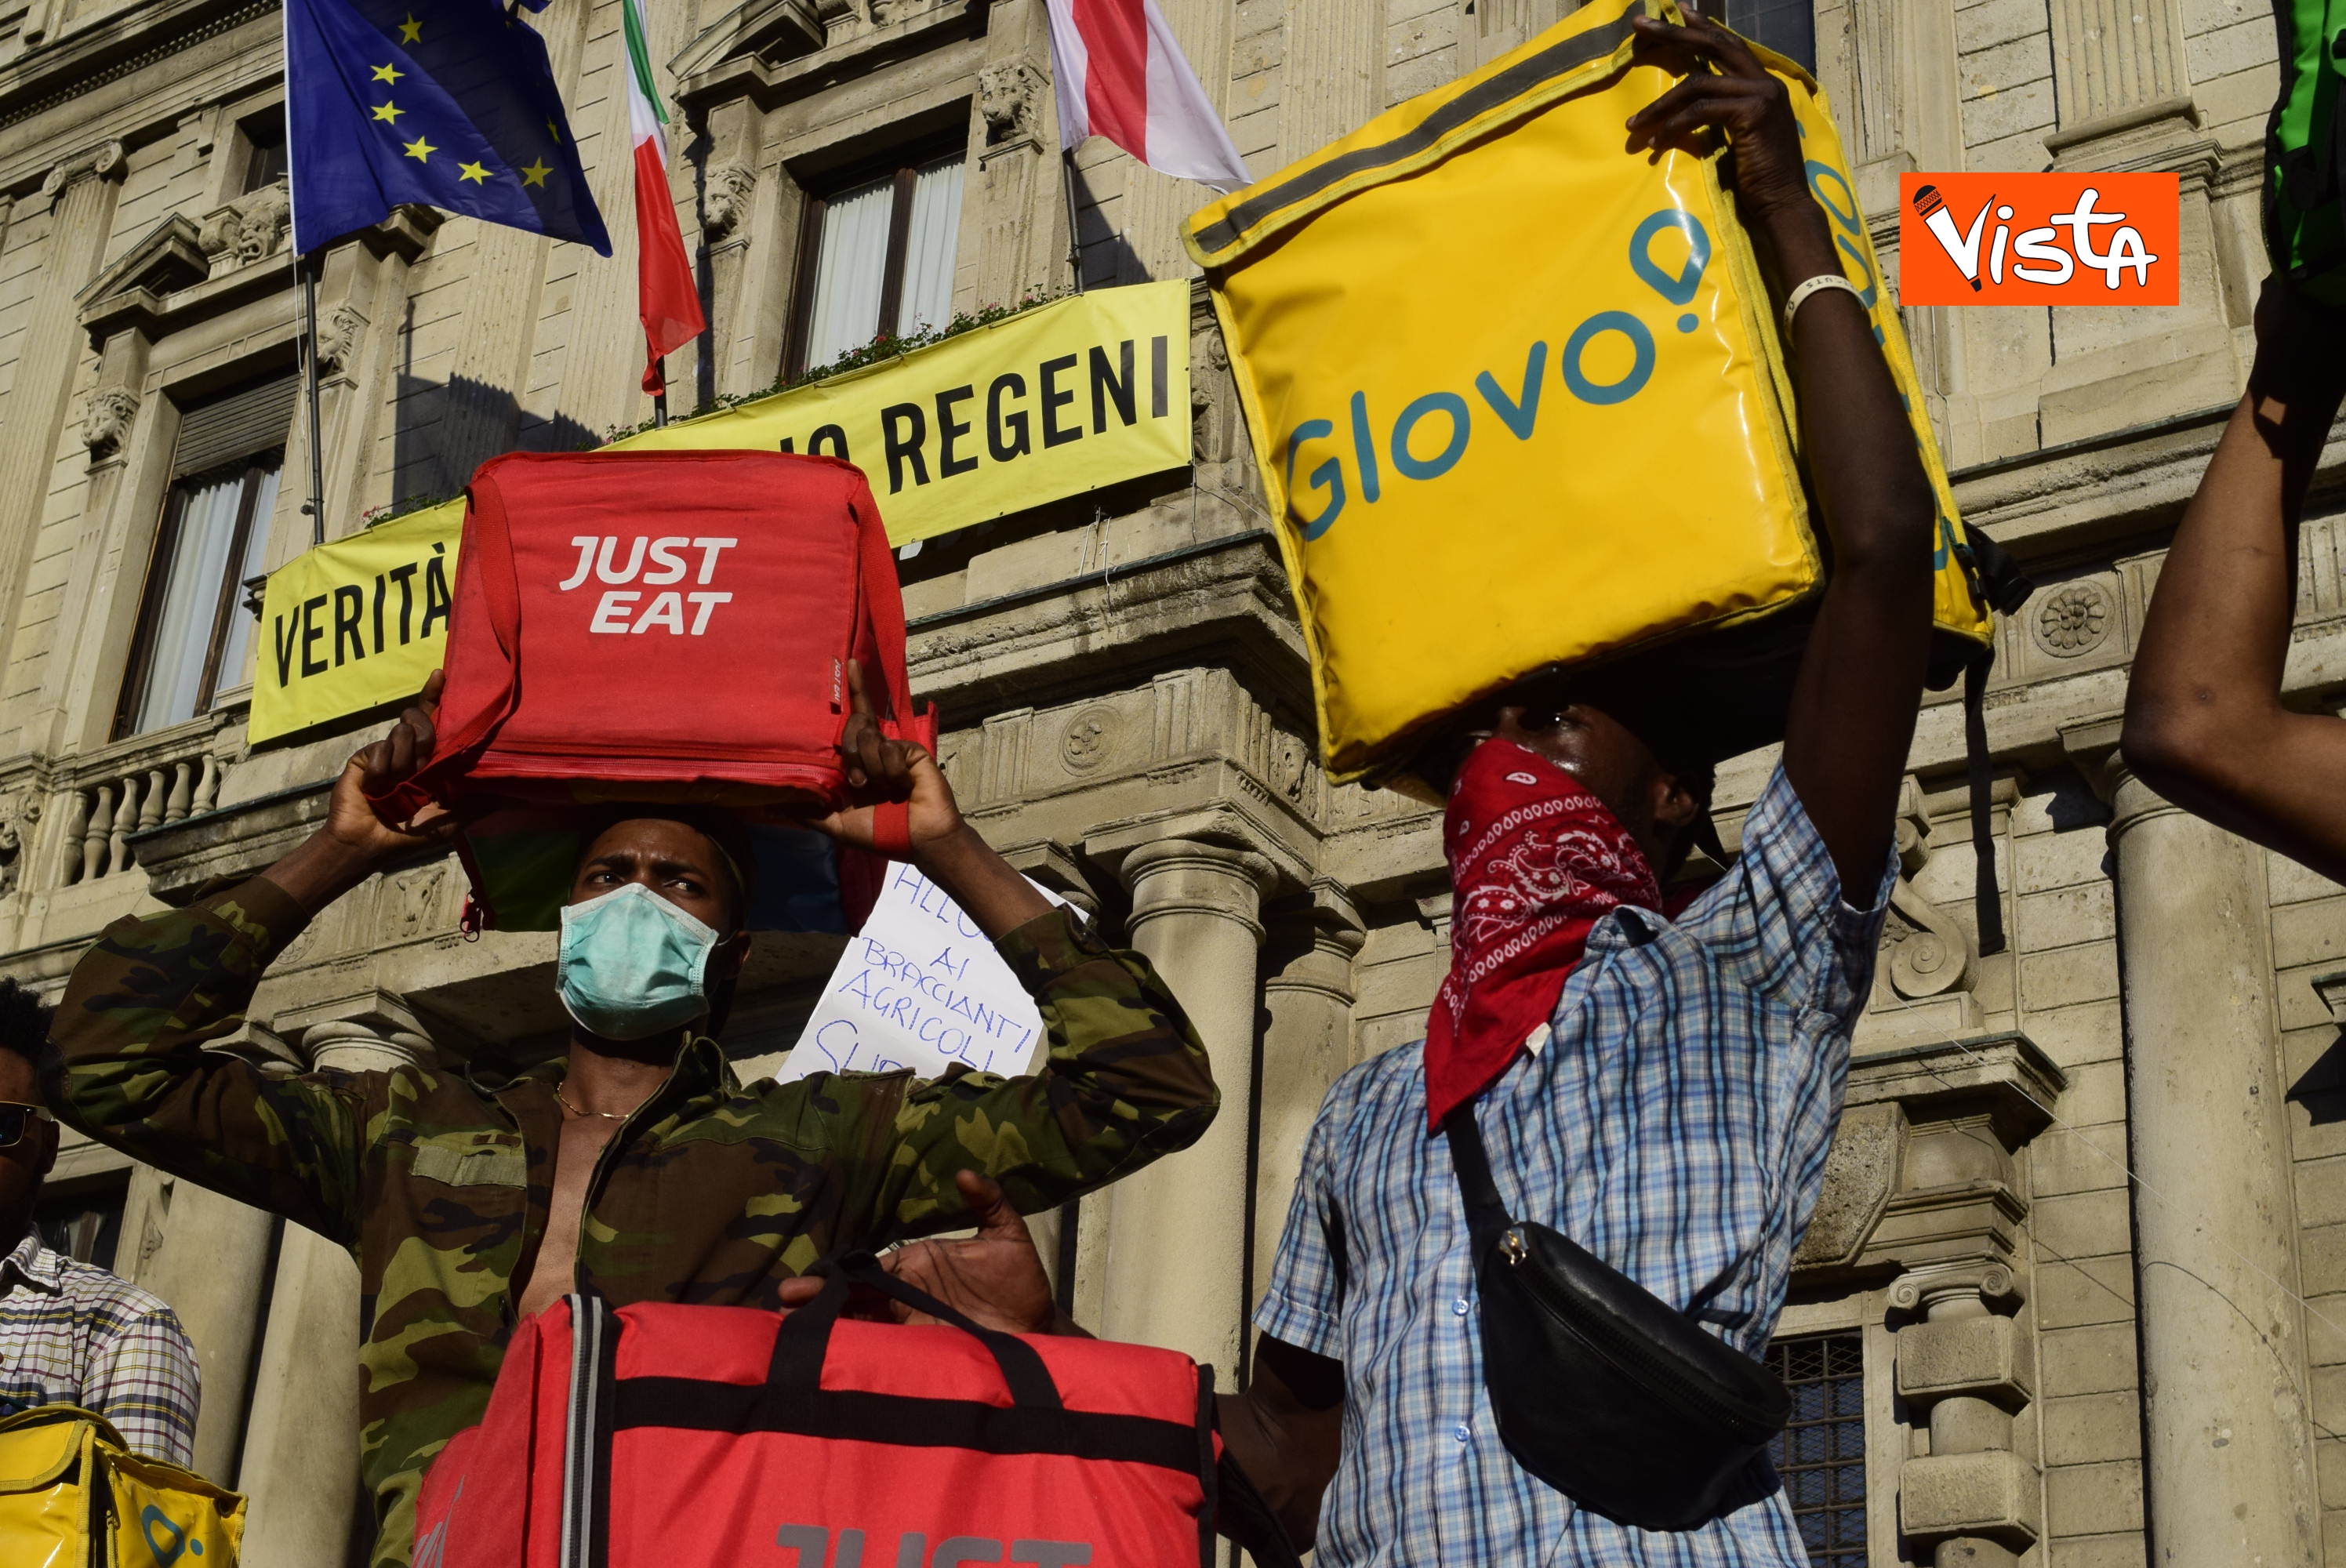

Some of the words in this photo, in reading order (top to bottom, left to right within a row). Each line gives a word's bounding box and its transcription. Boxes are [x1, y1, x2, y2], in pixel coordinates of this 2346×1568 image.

[1287, 310, 1656, 542] Glovo
[275, 541, 452, 688] VERITÀ
[881, 335, 1168, 495] REGENI
[559, 536, 737, 590] JUST
[590, 592, 732, 635] EAT
[862, 937, 1031, 1053] BRACCIANTI
[929, 946, 970, 981] AI
[838, 969, 993, 1072] AGRICOLI
